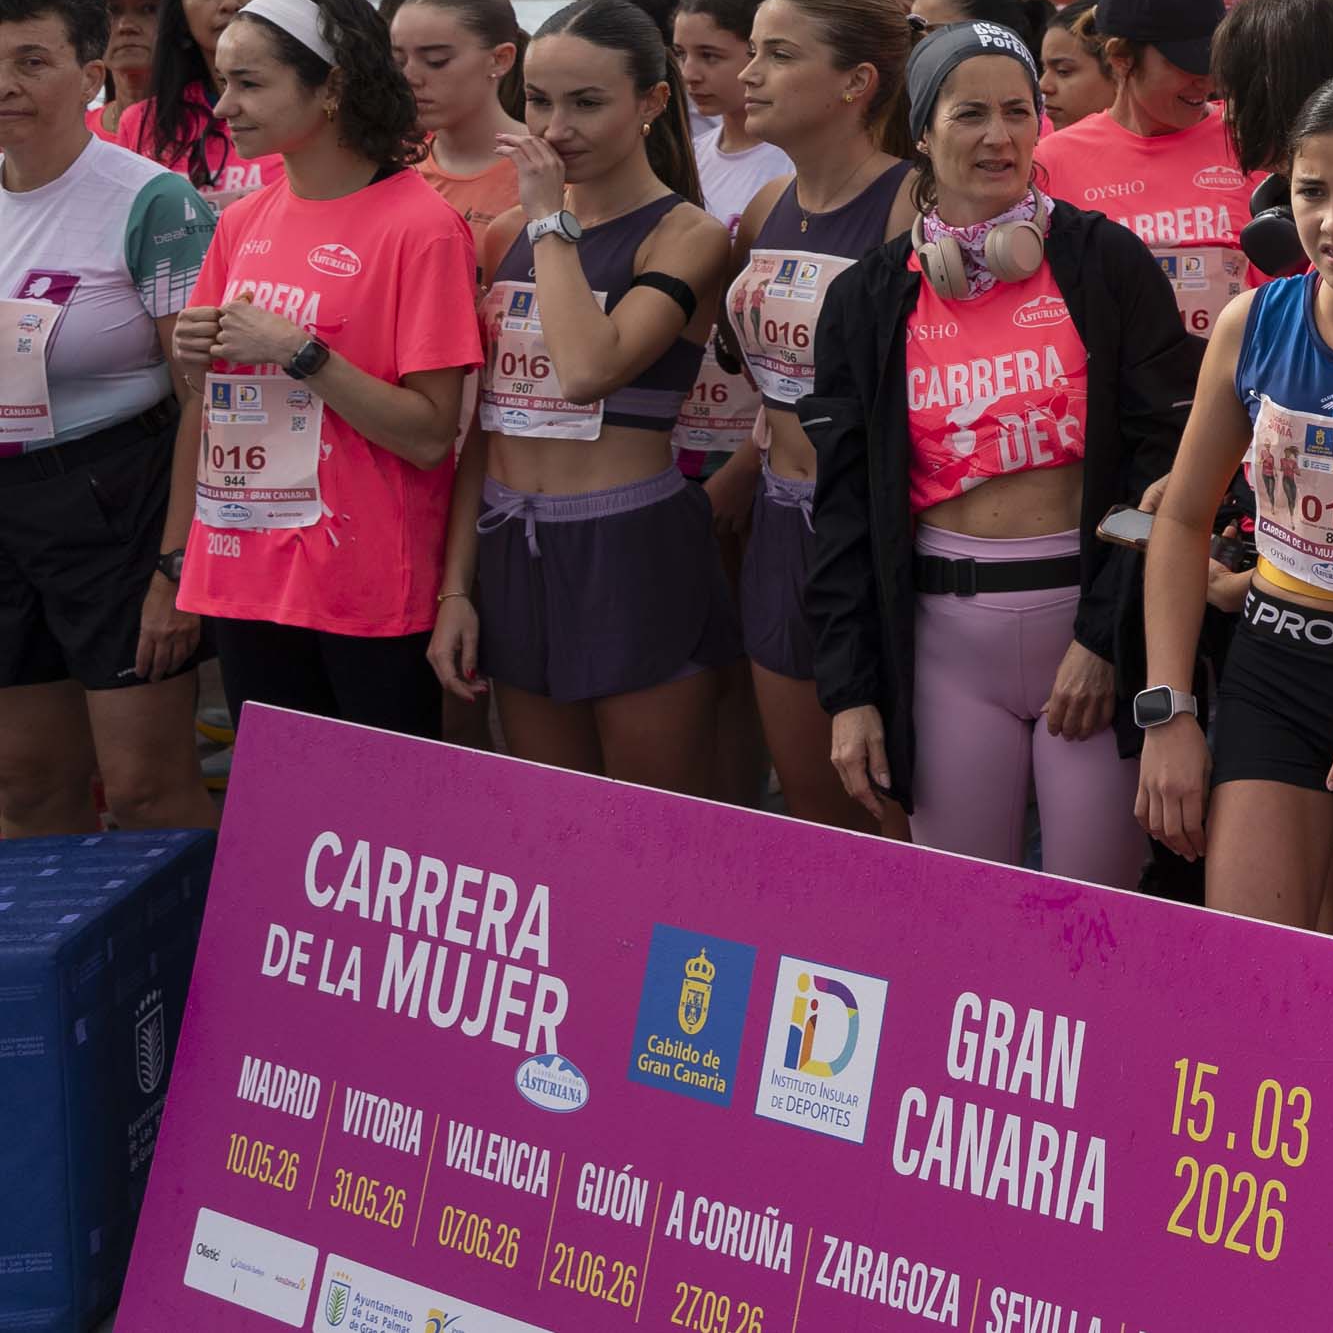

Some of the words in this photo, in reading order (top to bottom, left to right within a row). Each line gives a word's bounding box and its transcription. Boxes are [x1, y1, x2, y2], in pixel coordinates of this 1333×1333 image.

[1084, 180, 1145, 202] OYSHO
[764, 319, 810, 347] 016
[501, 352, 551, 379] 016
[511, 382, 534, 394] 1907
[908, 345, 1070, 412] CARRERA
[213, 445, 266, 470] 016
[224, 475, 246, 486] 944
[207, 532, 241, 558] 2026
[1262, 521, 1291, 542] CARRERA
[1292, 537, 1302, 548] DE
[1303, 542, 1313, 553] LA
[305, 831, 551, 966] CARRERA
[261, 923, 311, 987] DE
[319, 938, 361, 1002] LA
[376, 933, 570, 1055] MUJER
[637, 1053, 671, 1078] Gran
[673, 1063, 727, 1093] Canaria
[647, 1034, 700, 1064] Cabildo
[702, 1049, 721, 1069] de
[946, 991, 1087, 1110] GRAN
[237, 1055, 323, 1120] MADRID
[520, 1073, 583, 1105] ASTURIANA
[785, 1097, 852, 1128] DEPORTES
[341, 1087, 424, 1157] VITORIA
[226, 1132, 301, 1193] 10.05.26
[445, 1121, 551, 1199] VALENCIA
[891, 1086, 1106, 1232] CANARIA
[330, 1168, 406, 1229] 31.05.26
[576, 1164, 651, 1228] GIJÓN
[1166, 1156, 1288, 1262] 2026
[438, 1204, 520, 1269] 07.06.26
[665, 1191, 687, 1238] A
[688, 1195, 794, 1274] CORUÑA
[550, 1241, 639, 1309] 21.06.26
[815, 1234, 961, 1328] ZARAGOZA
[352, 1306, 362, 1318] de
[365, 1309, 379, 1324] Las
[354, 1292, 413, 1322] Ayuntamiento
